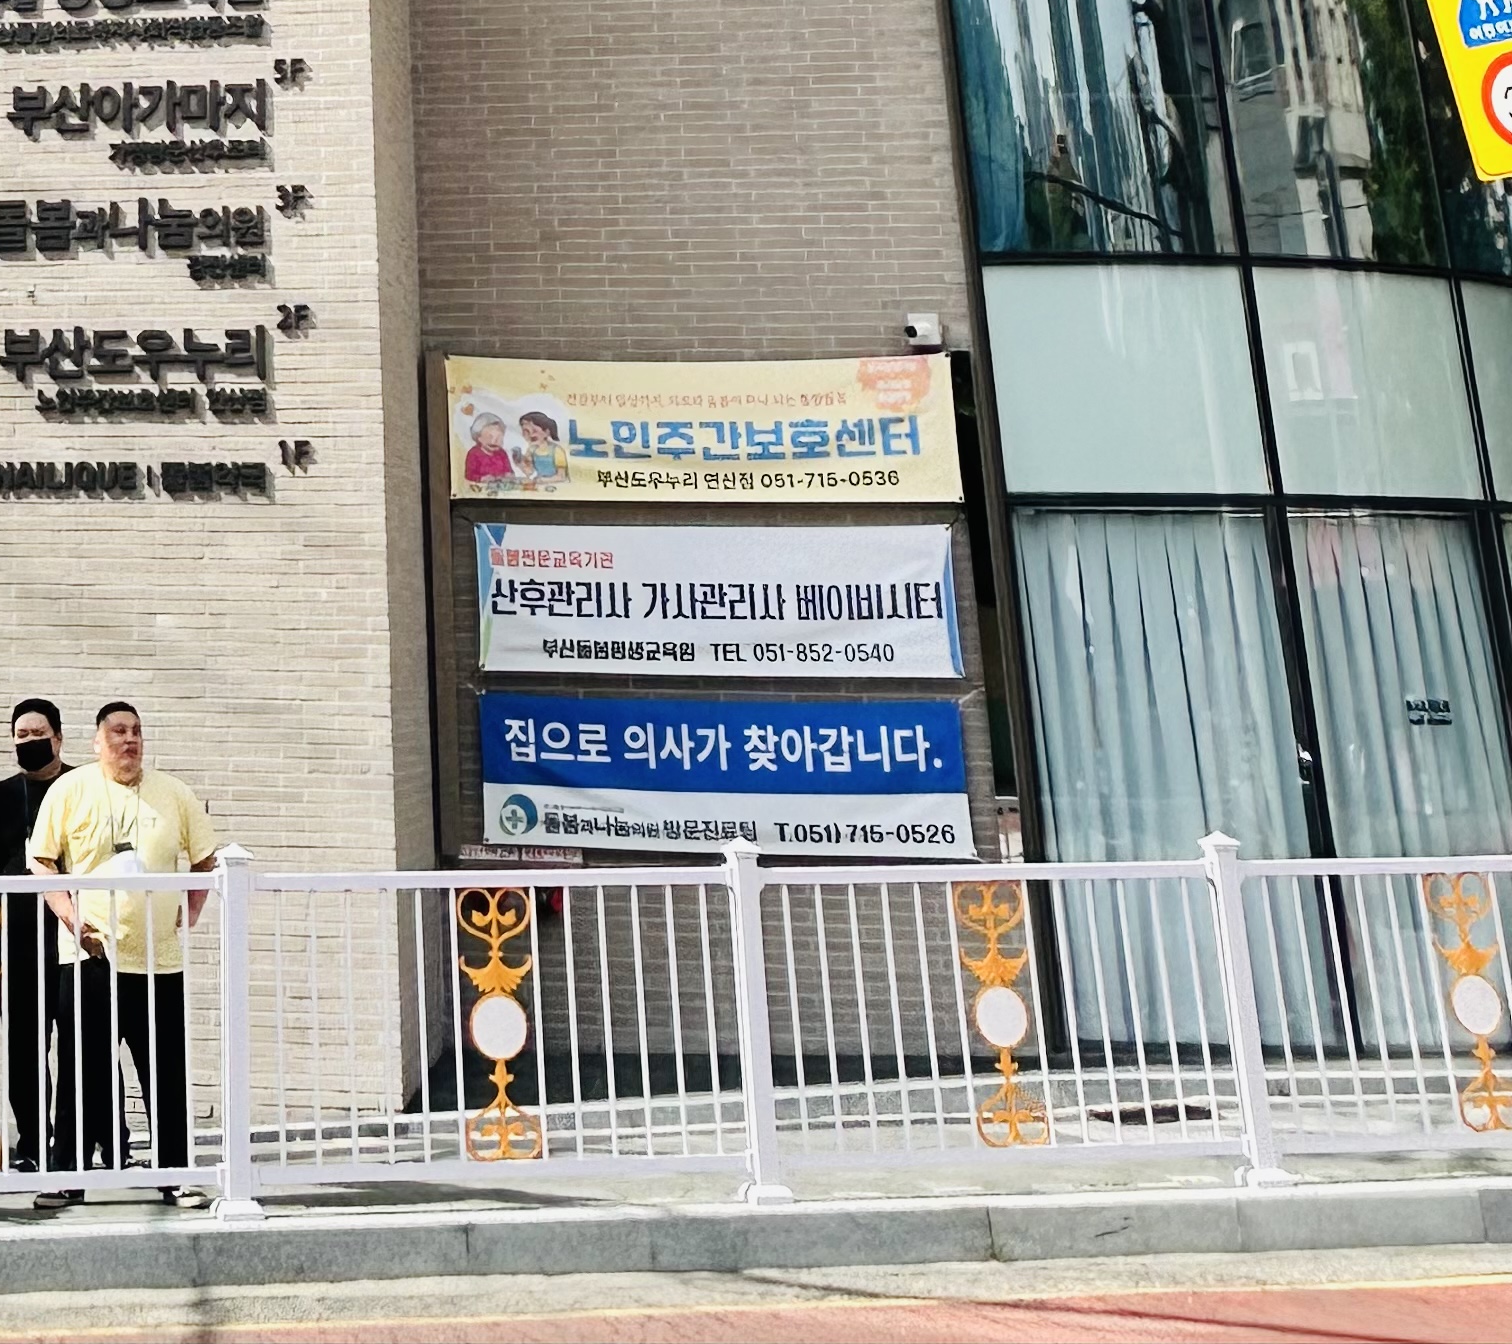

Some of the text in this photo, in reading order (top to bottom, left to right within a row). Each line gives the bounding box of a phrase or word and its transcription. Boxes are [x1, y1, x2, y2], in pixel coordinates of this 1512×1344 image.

[7, 78, 266, 138] 부산아가마지
[568, 415, 921, 461] 노인주간보호센터
[597, 470, 698, 490] 부산도우누리
[760, 470, 900, 489] 051-715-0536
[491, 578, 944, 622] 산후관리사 가사관리사 베이비시터
[542, 639, 895, 663] 부산돌봄평생교육원 TEL 051-852-0540
[504, 717, 944, 774] 집으로 의사가 찾아갑니다.
